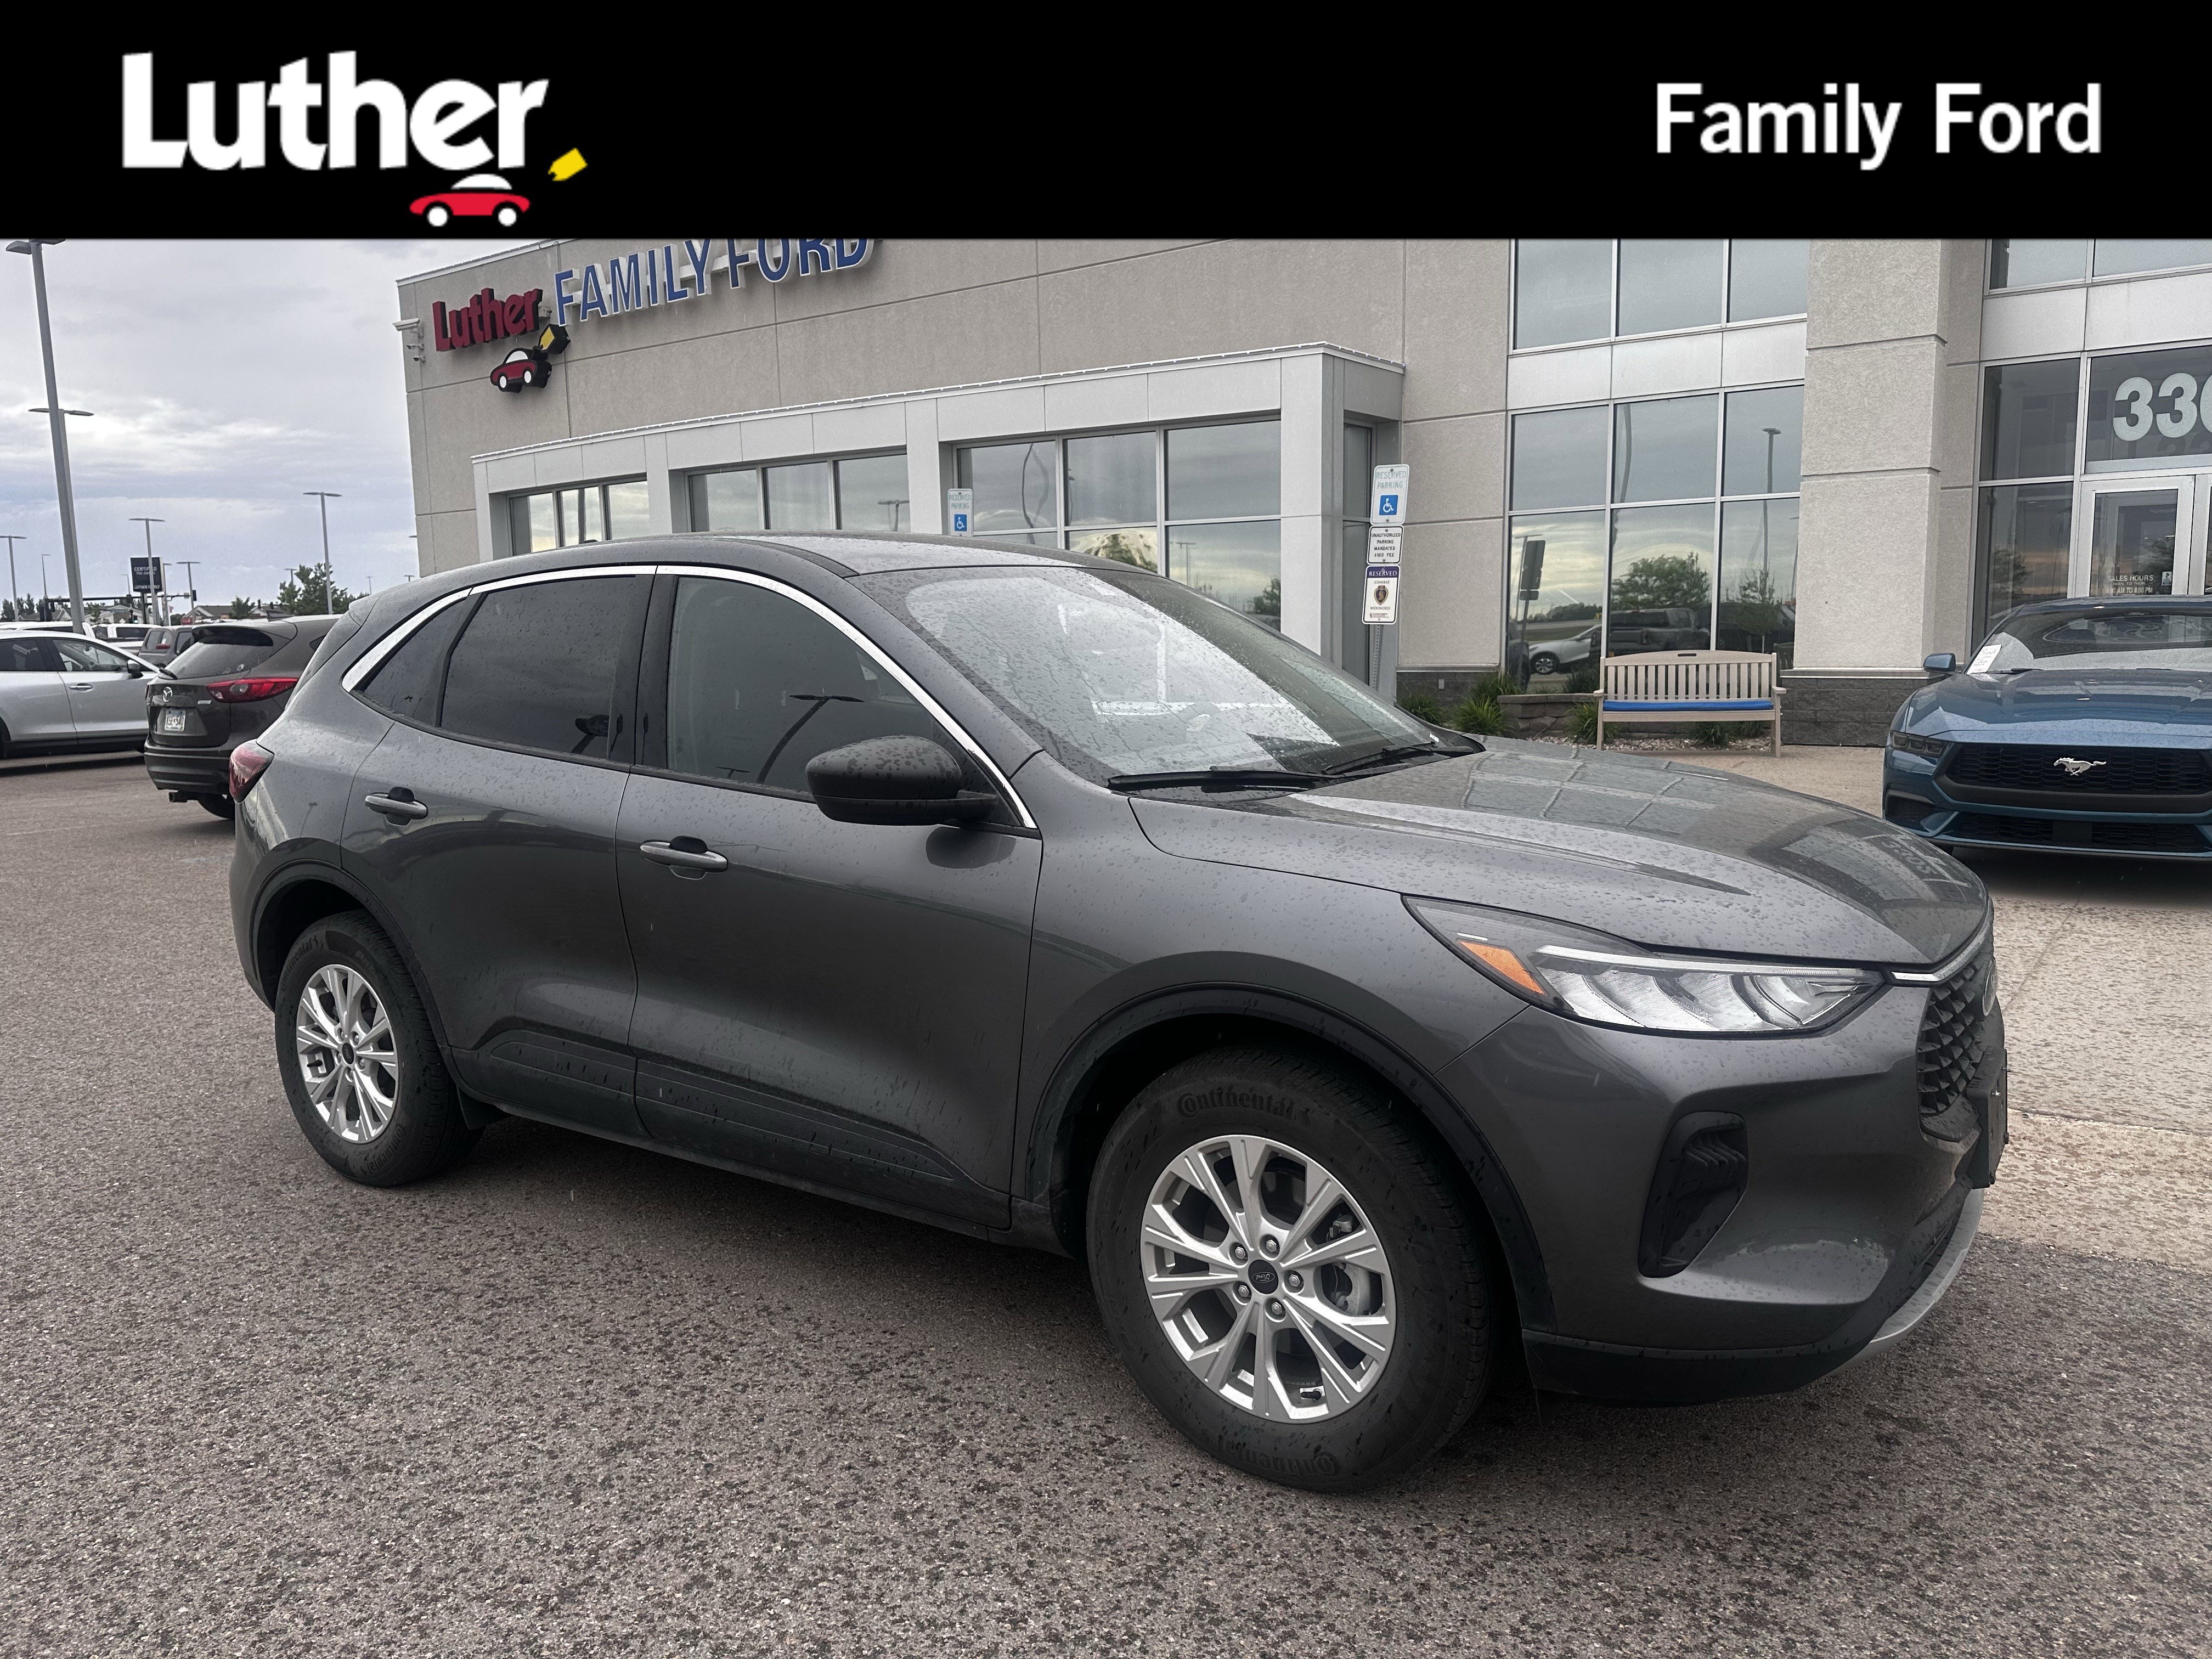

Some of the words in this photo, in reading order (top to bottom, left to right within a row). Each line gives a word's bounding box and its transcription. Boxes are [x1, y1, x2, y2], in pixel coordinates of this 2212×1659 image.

[555, 239, 712, 326] FAMILY
[432, 287, 543, 351] Luther
[1377, 481, 1403, 489] PARKING
[1177, 1085, 1295, 1122] Continental
